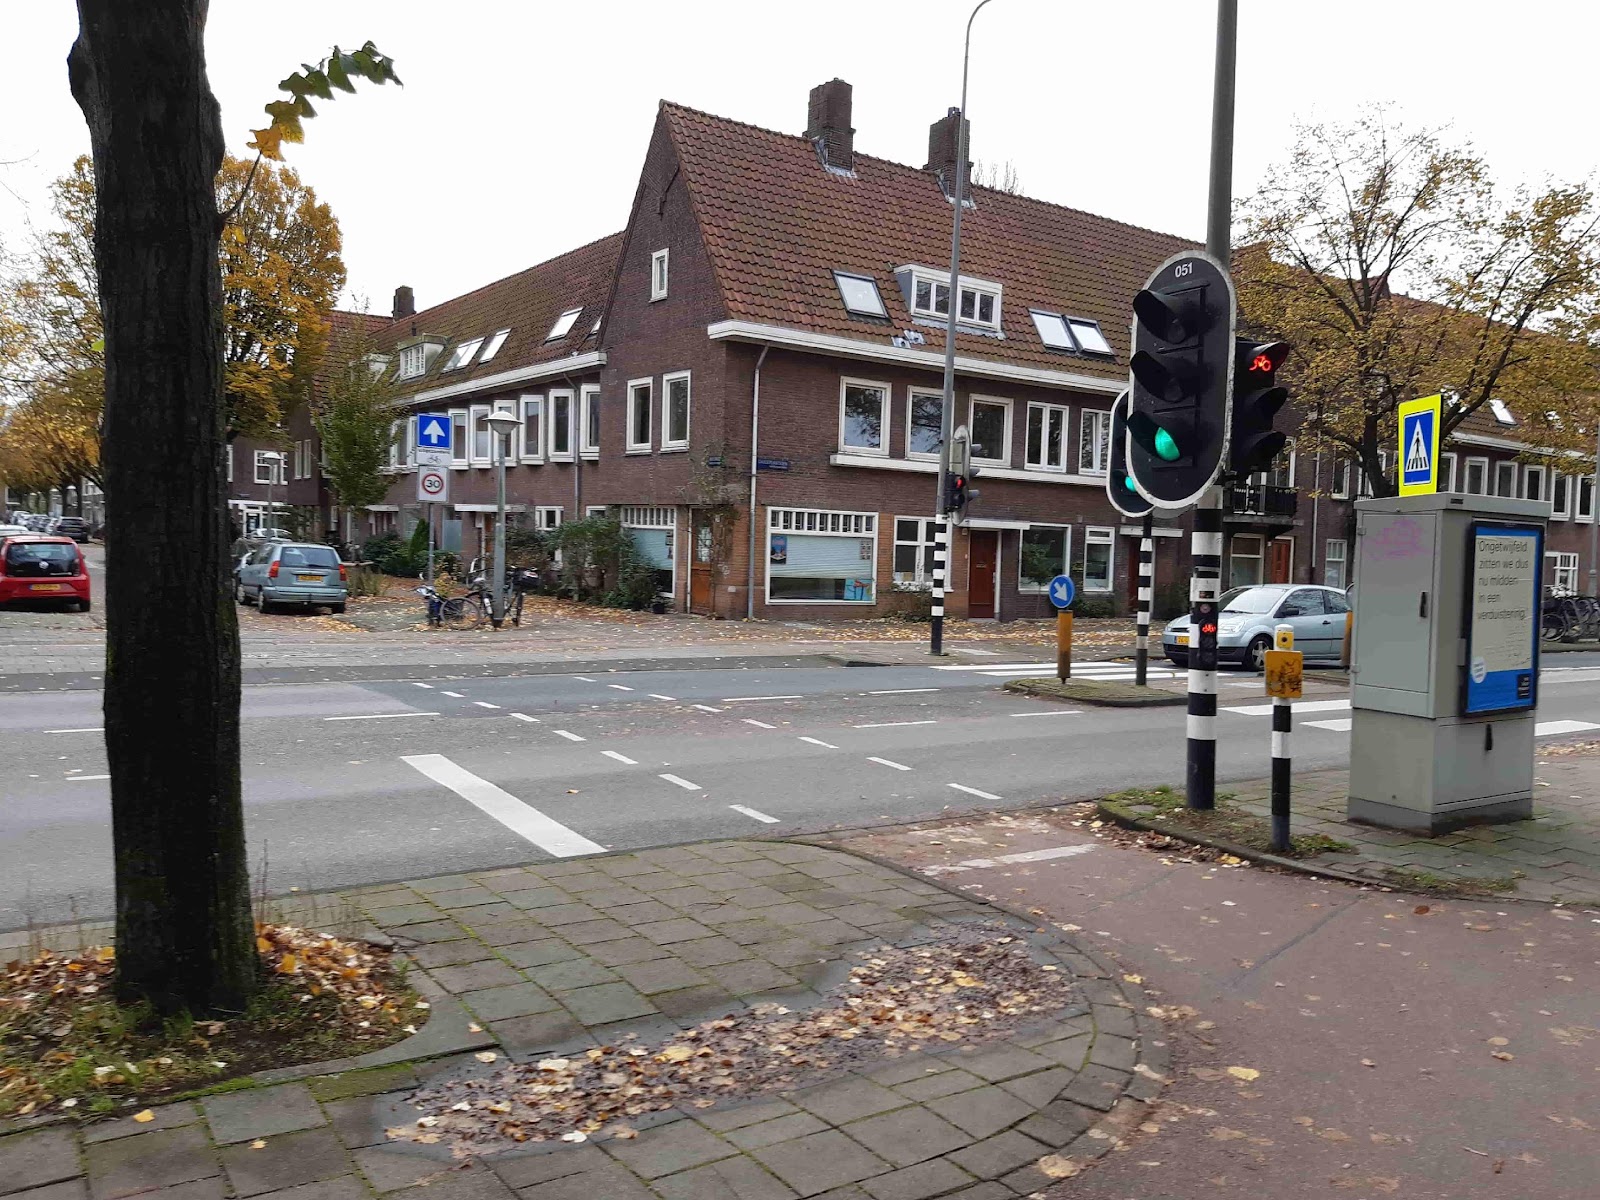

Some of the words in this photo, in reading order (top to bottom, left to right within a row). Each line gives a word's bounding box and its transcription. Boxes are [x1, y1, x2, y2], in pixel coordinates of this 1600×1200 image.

[1175, 262, 1193, 278] 051
[426, 479, 441, 489] 30
[1478, 557, 1501, 569] zitten
[1502, 559, 1514, 569] we
[1515, 558, 1529, 569] dus
[1478, 577, 1489, 586] nu
[1490, 574, 1519, 586] midden
[1487, 593, 1502, 603] een
